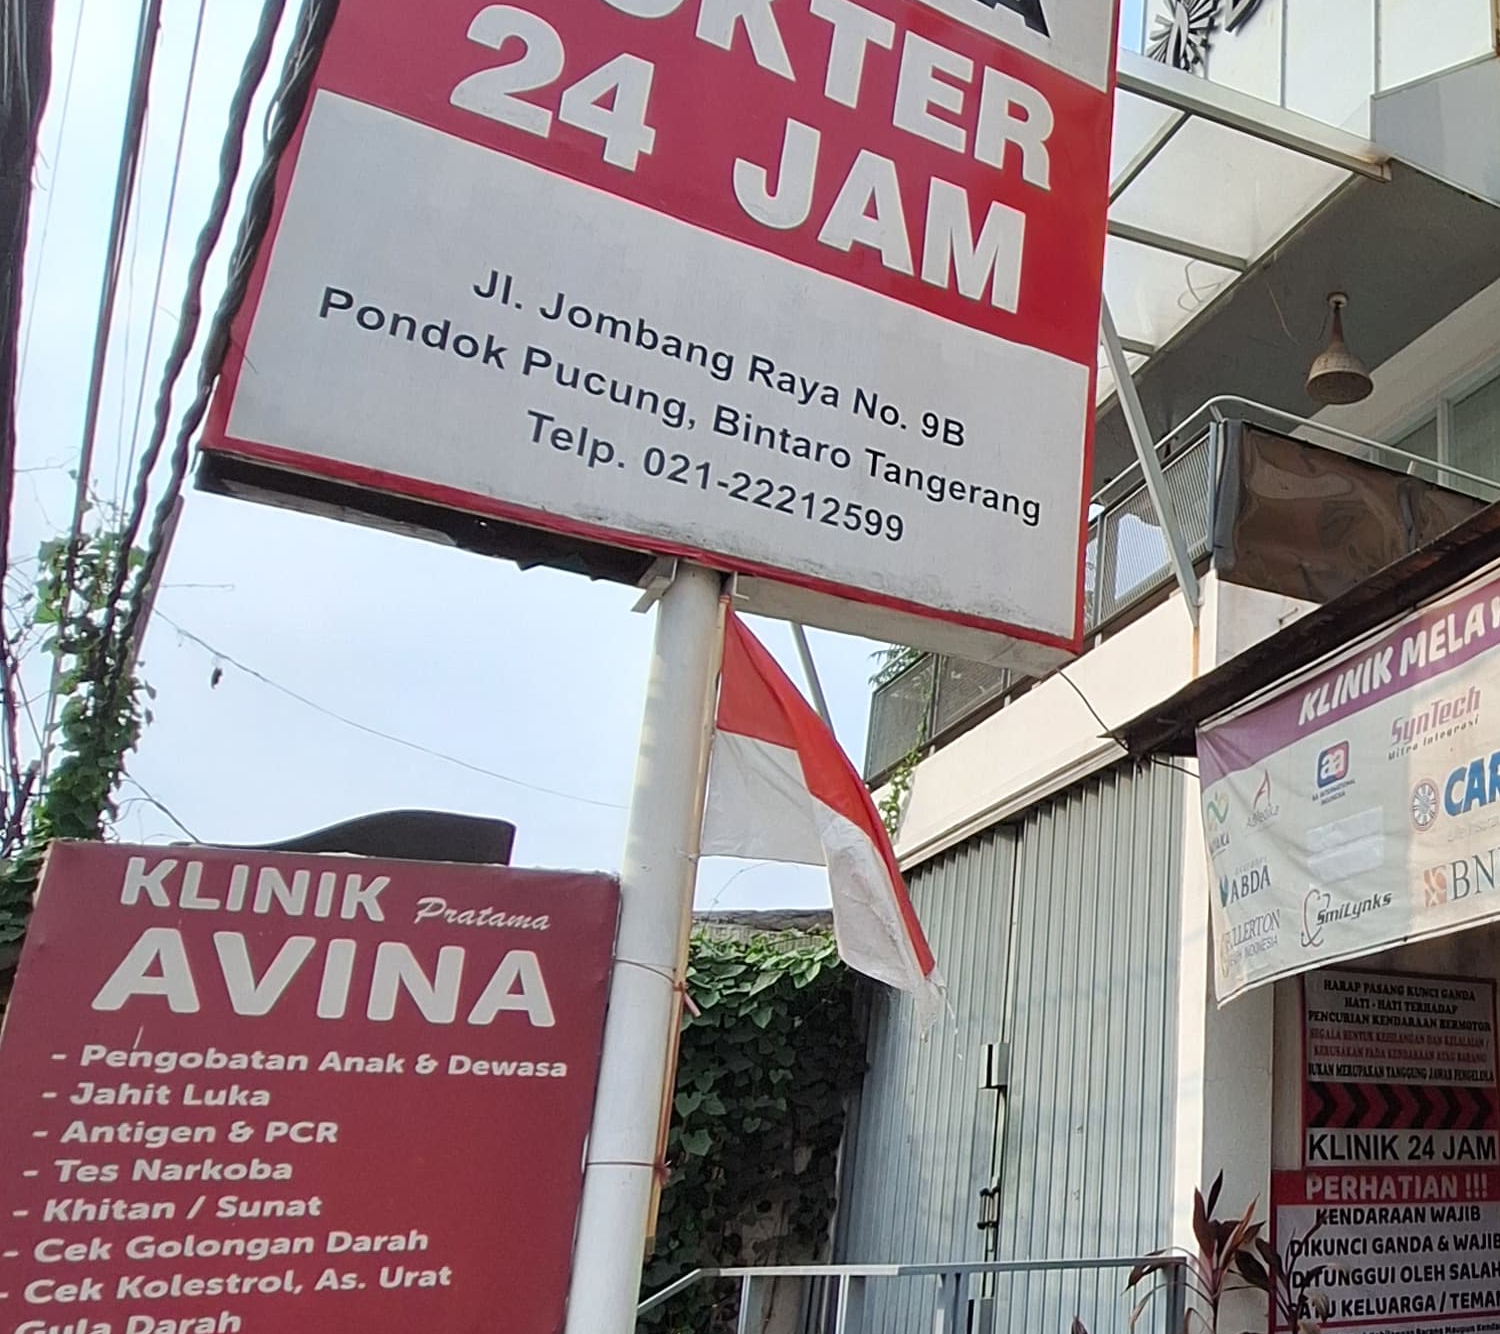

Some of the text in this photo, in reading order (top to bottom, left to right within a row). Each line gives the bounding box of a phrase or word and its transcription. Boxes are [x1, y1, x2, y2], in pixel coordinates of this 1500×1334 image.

[449, 4, 1026, 314] 24 JAM
[472, 269, 966, 448] Jl. Jombang Raya No. 9B
[319, 286, 1041, 527] Pondok Pucung, Bintaro Tangerang
[527, 410, 905, 543] Telp. 021-22212599
[1299, 646, 1393, 726] KLINIK
[1390, 686, 1481, 748] SynTech
[121, 856, 551, 932] KLINIK Pratama
[1230, 865, 1271, 903] ABDA
[91, 927, 555, 1027] AVINA
[1323, 979, 1361, 993] HARAP
[1363, 982, 1404, 996] PASANG
[1407, 985, 1439, 998] KUNCI
[80, 1044, 567, 1078] Pengobatan Anak Dewasa
[70, 1082, 271, 1107] Jahit Luka
[60, 1121, 338, 1148] Antigen PCR
[1308, 1134, 1497, 1161] KLINIK 24 JAM
[54, 1158, 292, 1183] Tes Narkoba
[1306, 1174, 1458, 1201] PERHATIAN
[43, 1195, 321, 1222] Khitan Sunat
[1316, 1205, 1481, 1226] KENDARAAN WAJIB
[34, 1230, 429, 1263] Cek Golongan Darah
[1291, 1237, 1367, 1257] DIKUNCI
[1372, 1235, 1434, 1254] GANDA
[24, 1265, 452, 1304] Cek Kolestrol, As. Urat
[1400, 1264, 1445, 1283] OLEH
[1341, 1296, 1436, 1318] KELUARGA
